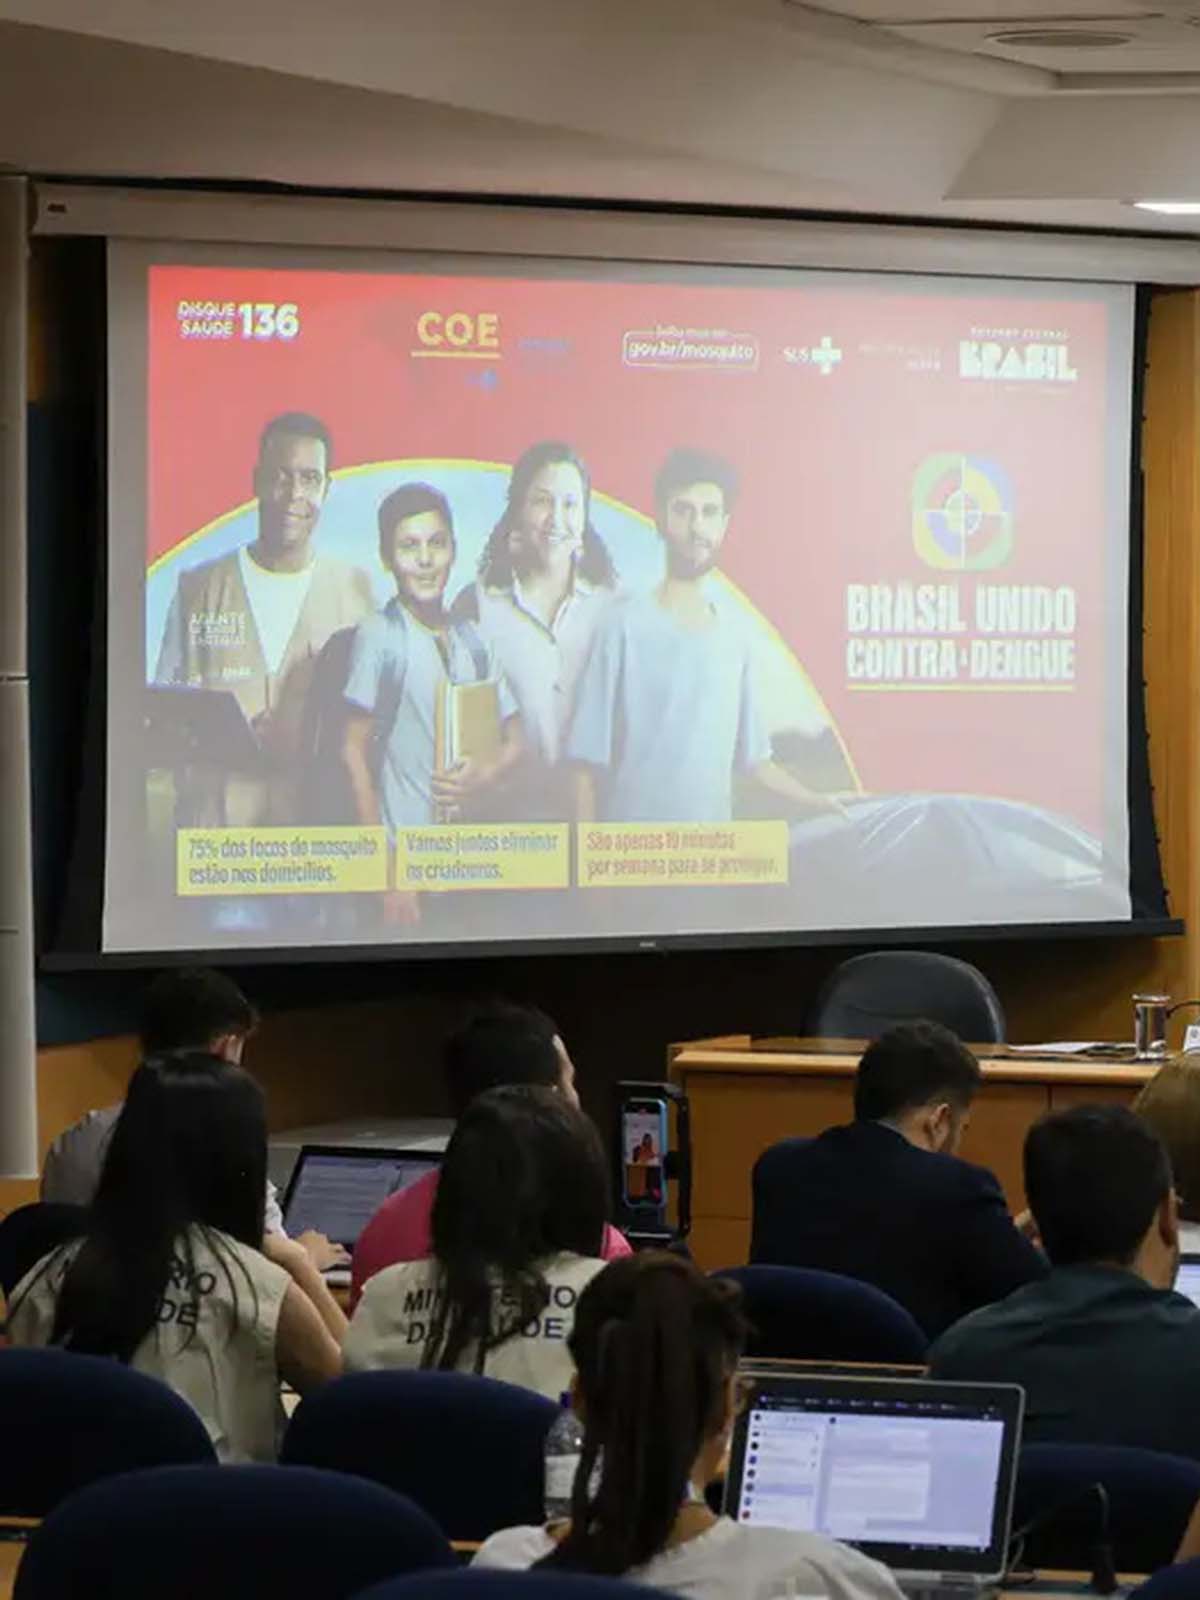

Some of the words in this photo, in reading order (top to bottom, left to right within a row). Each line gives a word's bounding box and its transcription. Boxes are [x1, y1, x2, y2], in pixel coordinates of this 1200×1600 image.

[239, 302, 299, 337] 136
[416, 312, 499, 346] COE
[847, 581, 968, 632] BRASIL
[975, 585, 1076, 633] UNIDO
[221, 837, 247, 857] dos
[406, 833, 453, 852] Vamos
[586, 831, 613, 850] São
[615, 832, 665, 854] apenas
